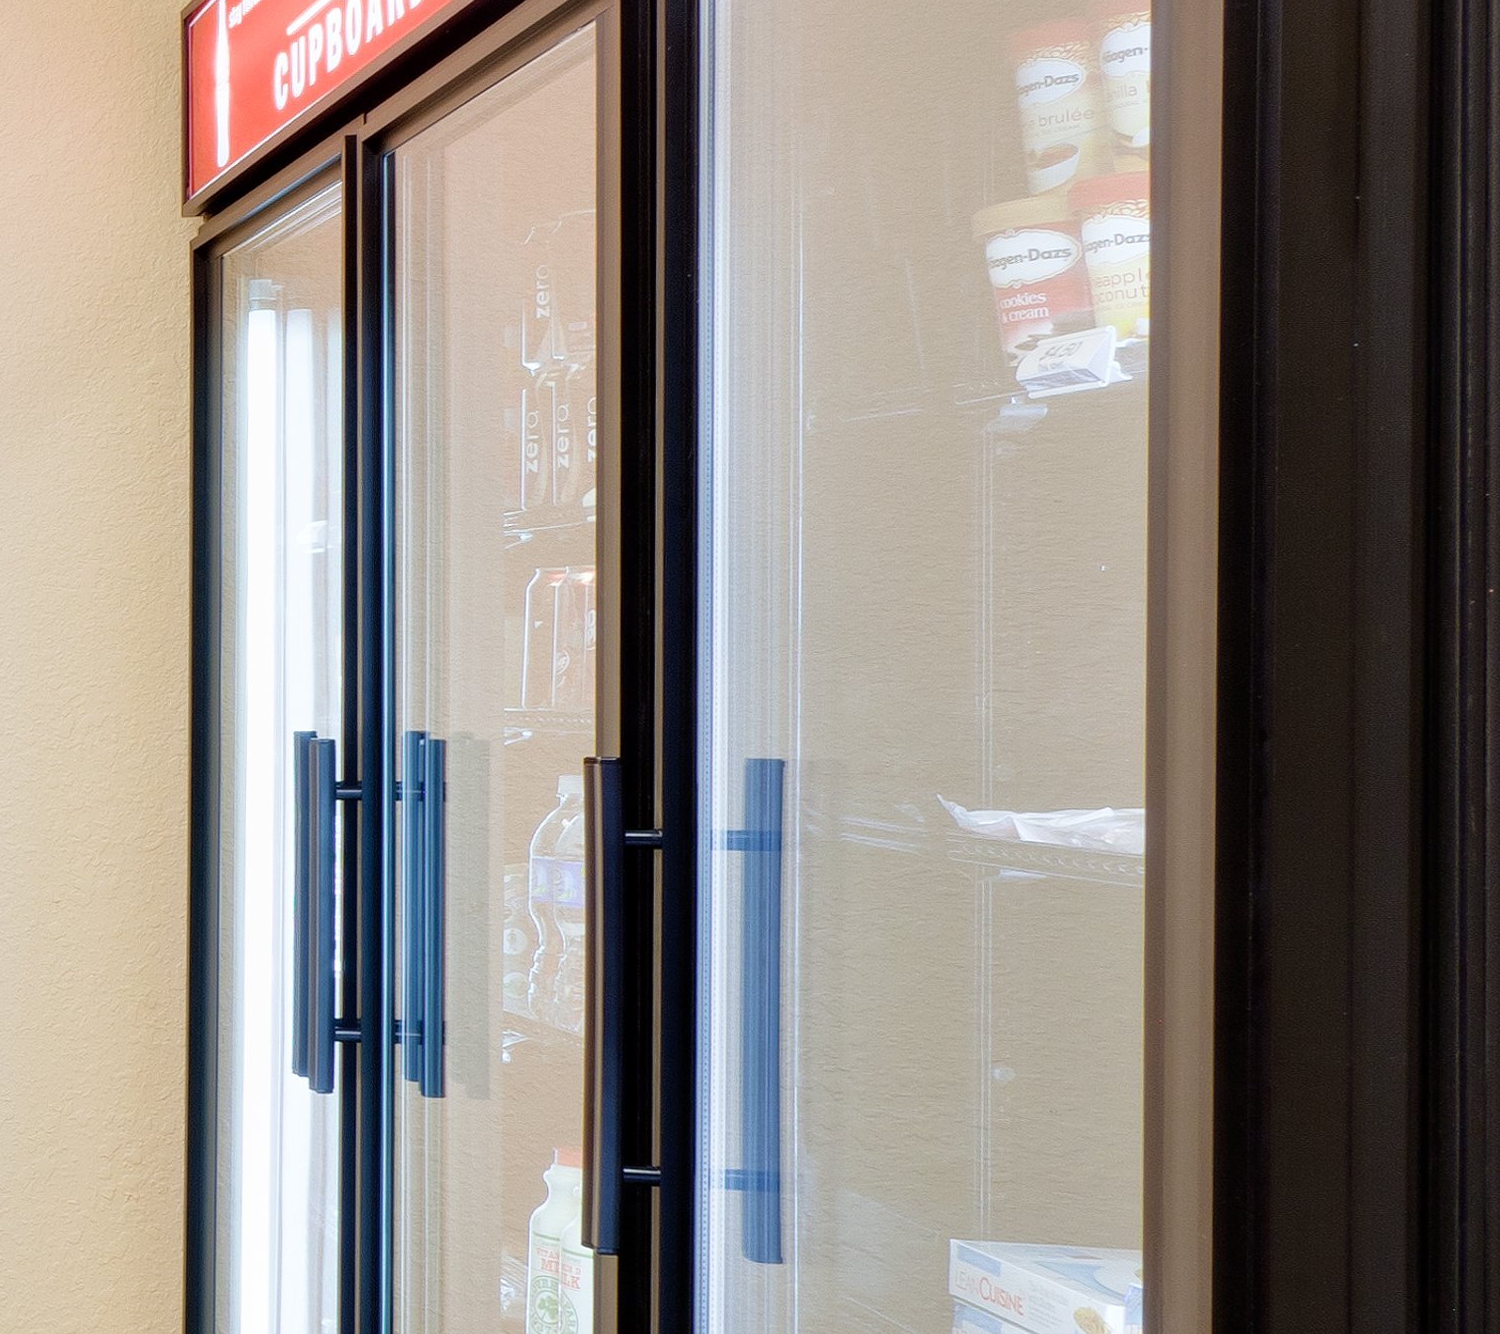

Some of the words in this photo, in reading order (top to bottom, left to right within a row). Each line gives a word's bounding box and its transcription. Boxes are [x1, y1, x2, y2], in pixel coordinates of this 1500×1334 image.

[536, 264, 550, 319] zero
[526, 410, 540, 474] zero
[557, 403, 570, 468] zero
[979, 1277, 1024, 1316] CUISINE
